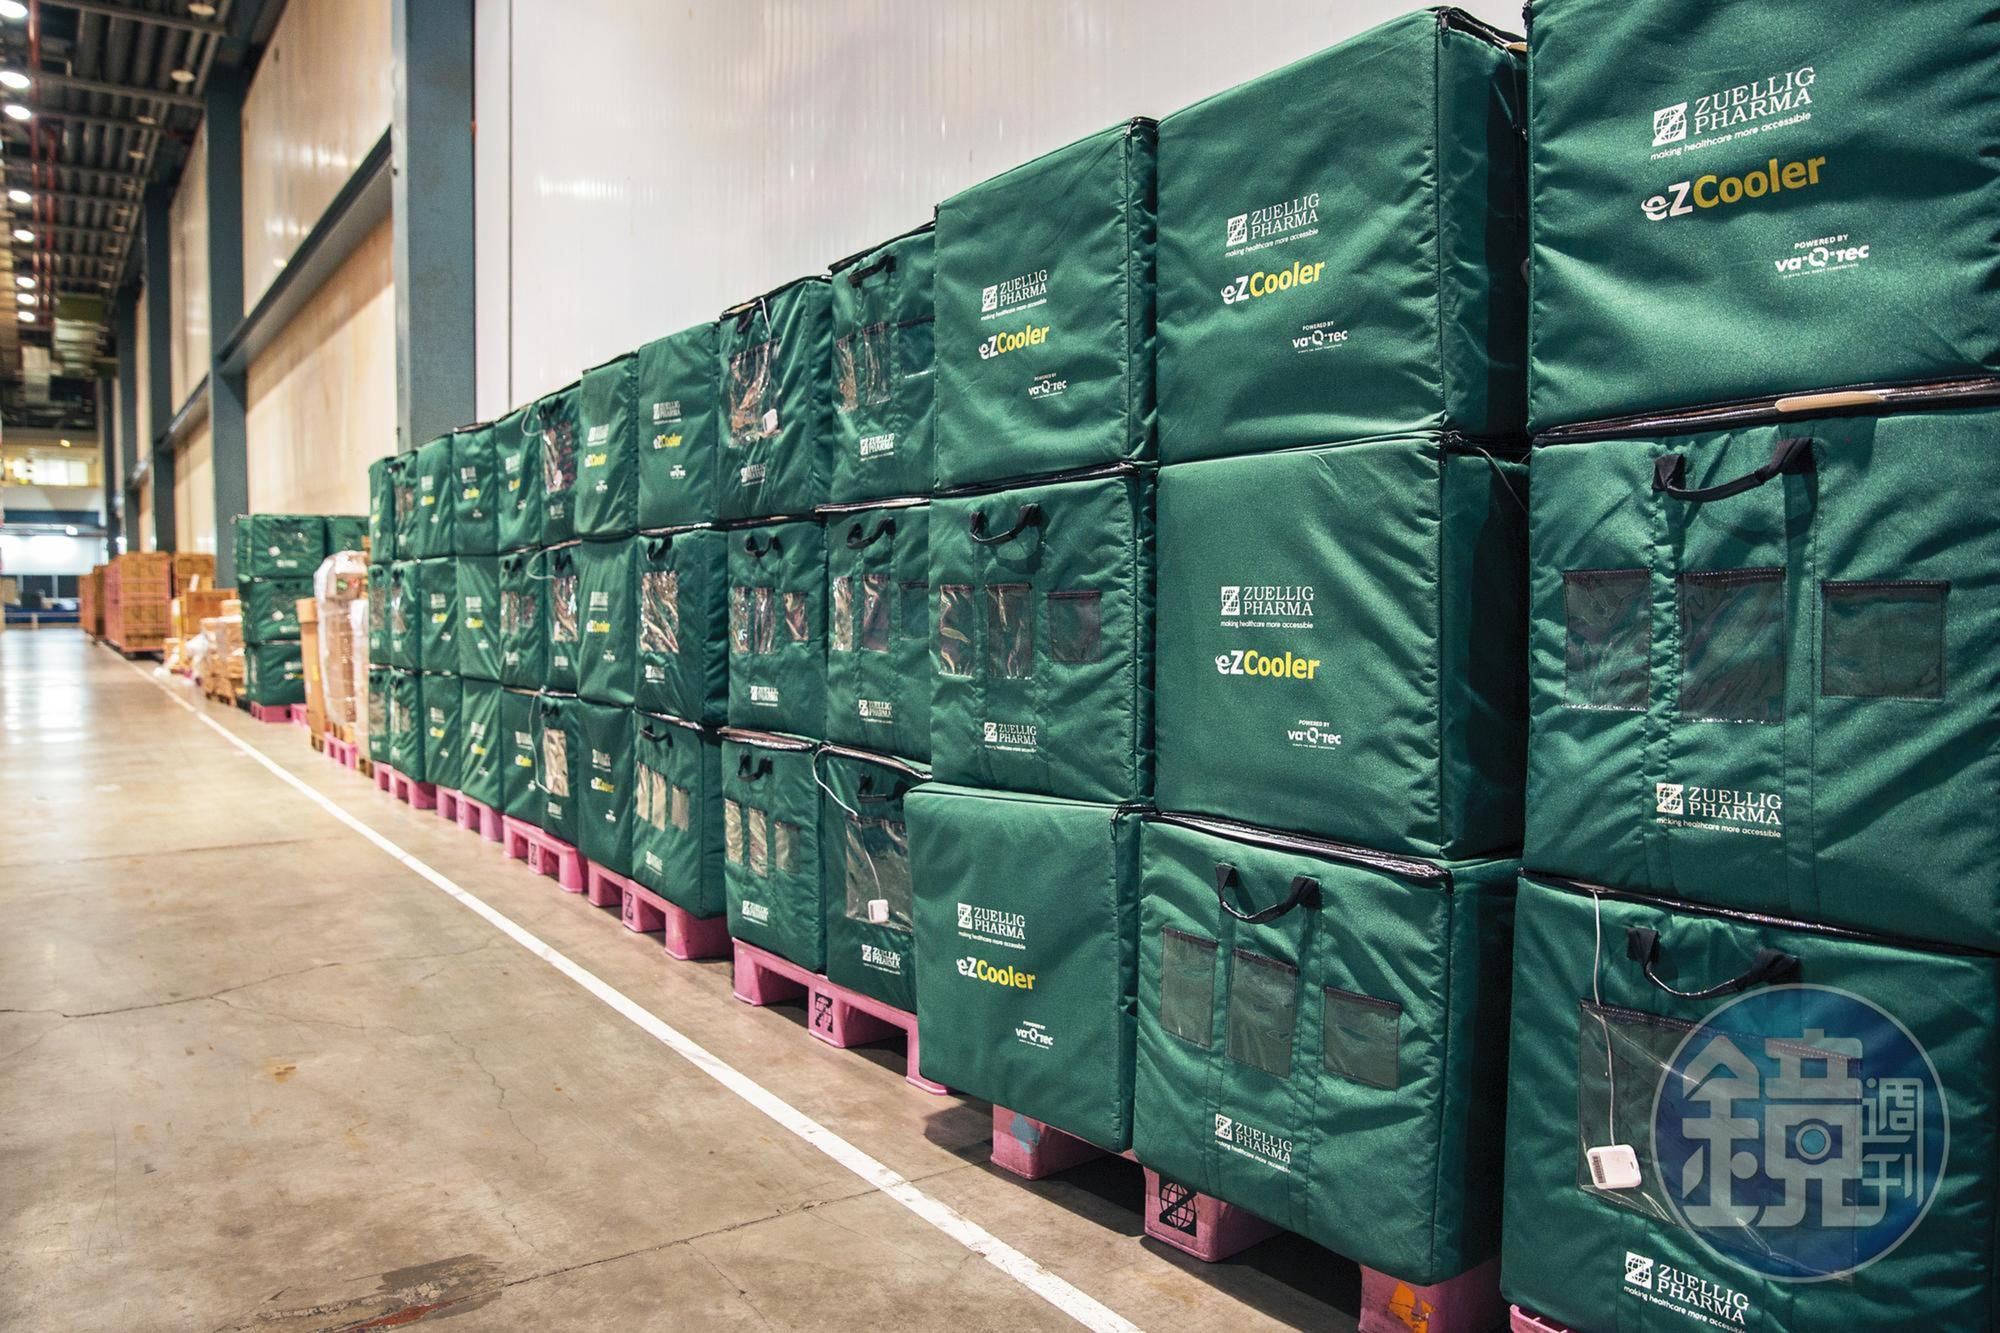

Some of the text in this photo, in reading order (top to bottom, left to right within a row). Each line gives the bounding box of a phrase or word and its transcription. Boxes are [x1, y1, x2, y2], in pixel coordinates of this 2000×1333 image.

[1694, 67, 1816, 117] ZUELLIG
[1694, 88, 1813, 134] PHARMA
[1651, 112, 1811, 160] making healthcare more accessible
[1641, 156, 1826, 221] eZCooler
[1251, 193, 1320, 225] ZUELLIG
[1251, 209, 1319, 239] PHARMA
[1794, 233, 1849, 249] POWERED BY
[999, 283, 1047, 307] PHARMA
[1000, 269, 1048, 295] ZUELLIG
[1221, 261, 1325, 305] eZCooler
[979, 324, 1050, 360] eZCooler
[1243, 586, 1315, 601] ZUELLIG
[1243, 601, 1314, 616] PHARMA
[1215, 650, 1321, 679] eZCooler
[998, 723, 1037, 736] ZUELLIG
[999, 732, 1037, 745] PHARMA
[1688, 787, 1783, 810] ZUELLIG
[1689, 801, 1781, 825] PHARMA
[1656, 817, 1682, 827] making
[1683, 820, 1720, 831] healthcare
[1742, 828, 1782, 838] accessible
[973, 907, 1026, 928] ZUELLIG
[974, 919, 1026, 940] PHARMA
[956, 956, 1036, 990] eZCooler
[1235, 1121, 1293, 1152] ZUELLIG
[1236, 1132, 1291, 1164] PHARMA
[1657, 1279, 1745, 1325] PHARMA
[1658, 1264, 1749, 1311] ZUELLIG
[1623, 1285, 1648, 1301] making
[1649, 1294, 1686, 1315] healthcare
[1688, 1310, 1708, 1322] more
